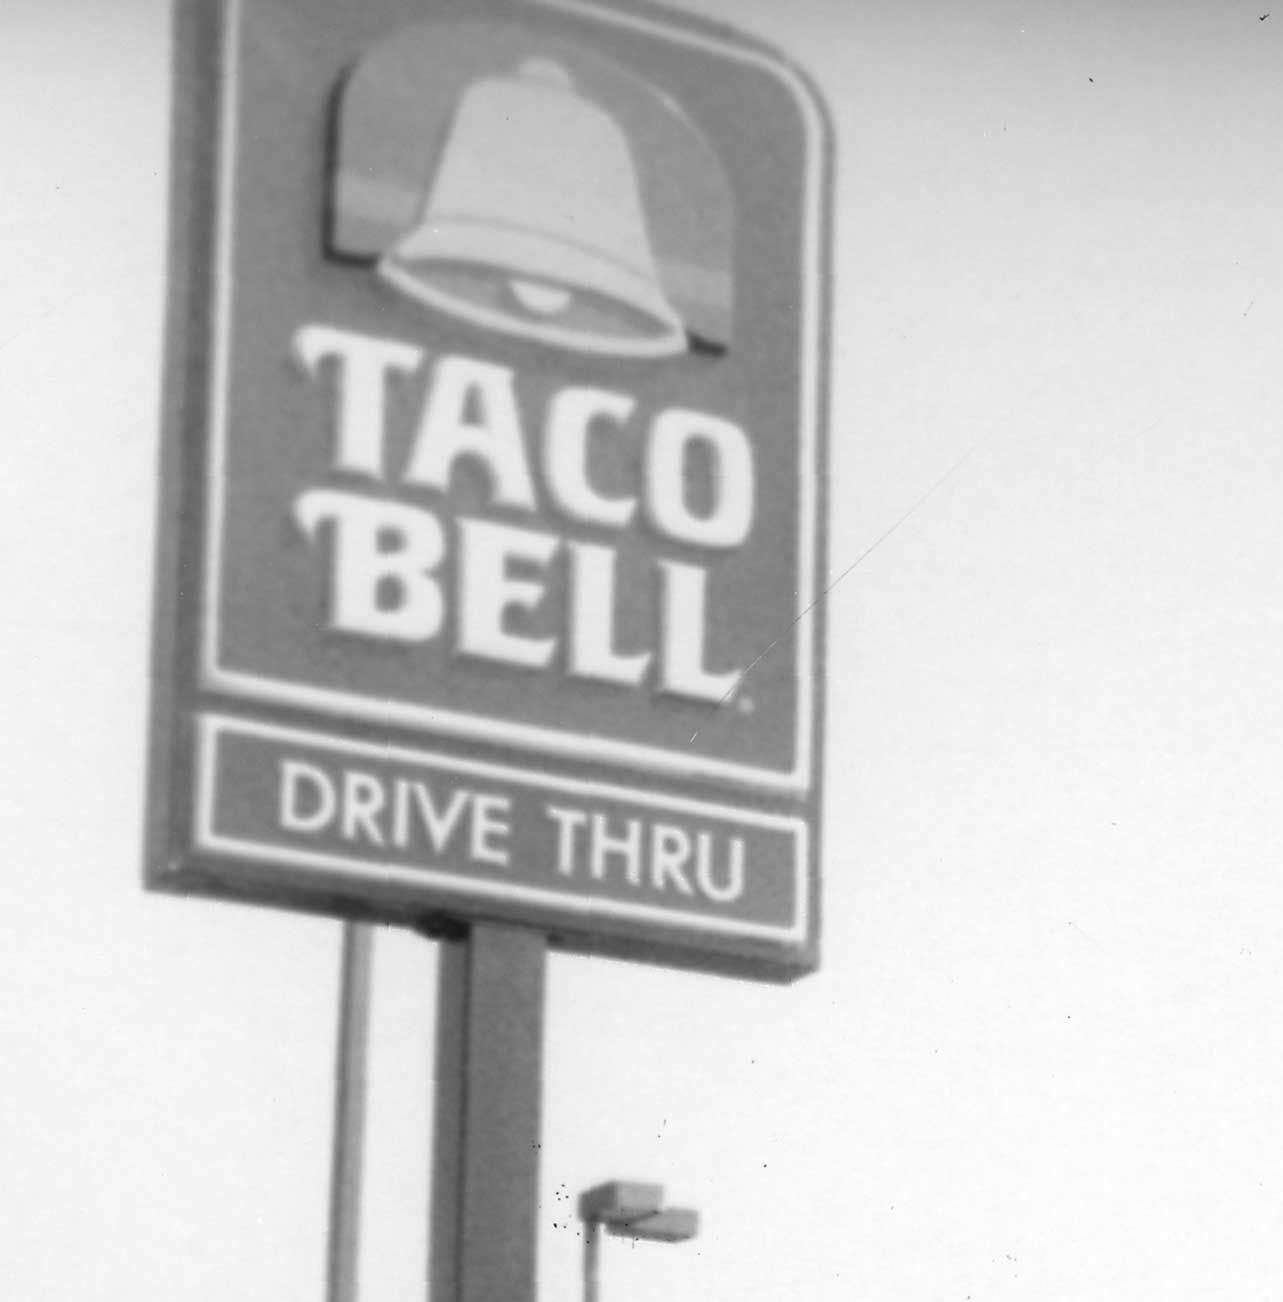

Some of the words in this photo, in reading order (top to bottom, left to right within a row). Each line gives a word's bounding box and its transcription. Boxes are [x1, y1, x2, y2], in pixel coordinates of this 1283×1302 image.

[290, 323, 754, 549] TACO
[293, 489, 746, 706] BELL
[279, 760, 511, 867] DRIVE
[547, 807, 746, 903] THRU
